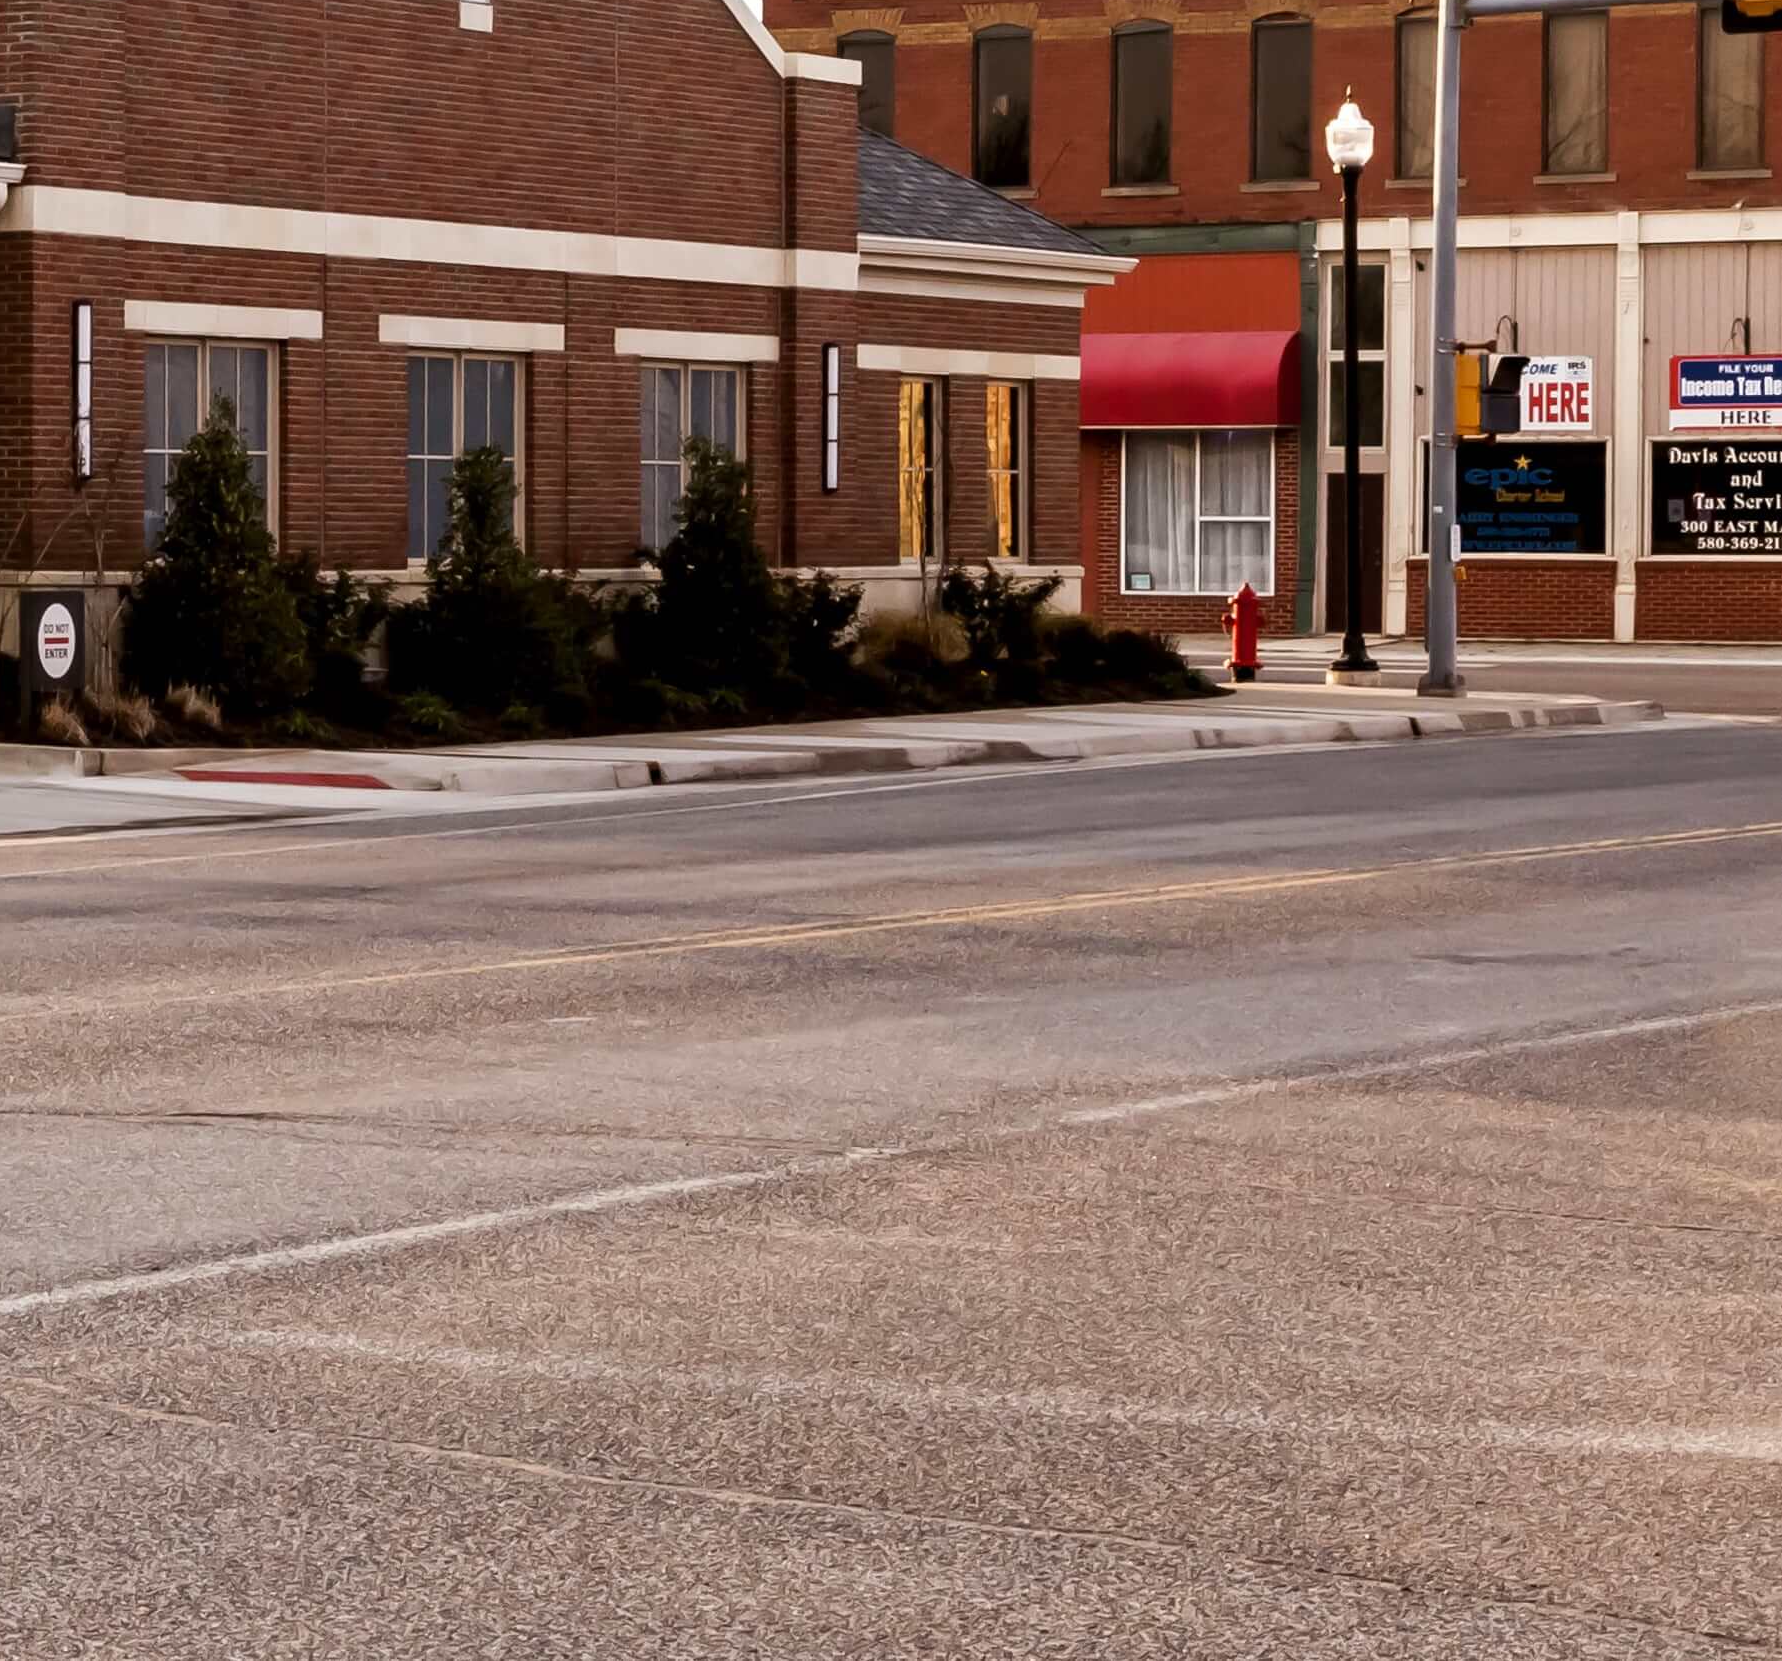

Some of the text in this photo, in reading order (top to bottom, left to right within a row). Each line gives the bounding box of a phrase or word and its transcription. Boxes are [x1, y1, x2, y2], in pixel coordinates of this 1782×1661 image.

[1718, 364, 1774, 373] FILE YOUR
[1681, 377, 1735, 397] Income
[1737, 376, 1762, 396] Tax
[1528, 382, 1590, 423] HERE
[1720, 410, 1773, 425] HERE
[1668, 446, 1782, 464] Davis Accou
[1464, 467, 1553, 490] epic
[1730, 469, 1763, 489] and
[1692, 492, 1726, 510] Tax
[1680, 520, 1708, 533] 300
[1713, 520, 1759, 533] EAST
[44, 624, 69, 634] DO NOT
[45, 648, 68, 659] ENTER
